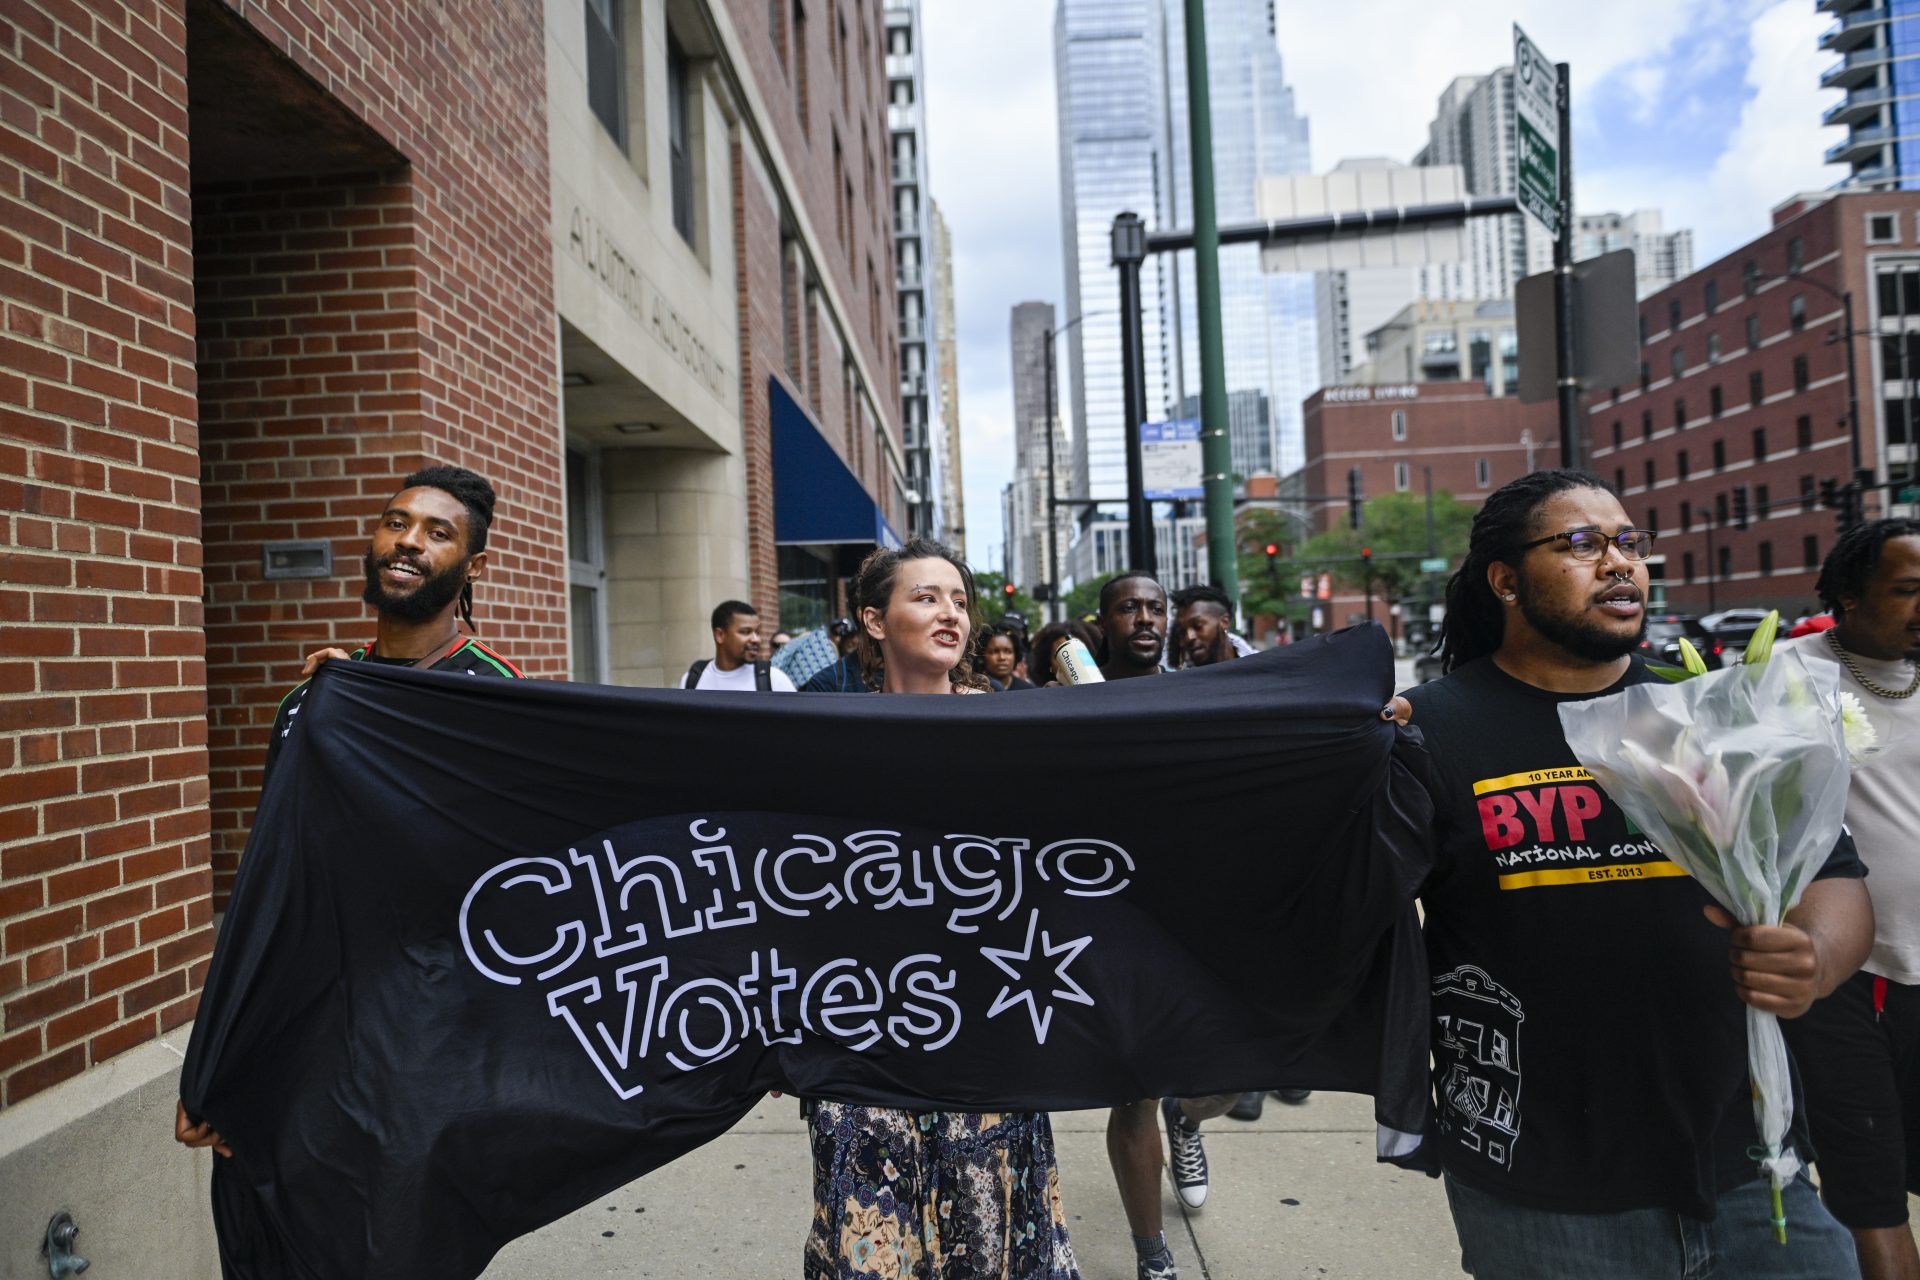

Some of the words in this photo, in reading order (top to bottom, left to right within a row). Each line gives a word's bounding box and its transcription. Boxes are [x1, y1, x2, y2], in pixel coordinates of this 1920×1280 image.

[1323, 387, 1370, 402] ACCESS
[1062, 650, 1079, 681] Chicago
[1529, 772, 1541, 783] 10
[1544, 769, 1574, 780] YEAR
[1477, 785, 1602, 850] BYP
[1588, 869, 1614, 880] EST.
[1616, 867, 1643, 878] 2013
[458, 819, 1135, 985] Chicago
[547, 947, 962, 1100] Votes
